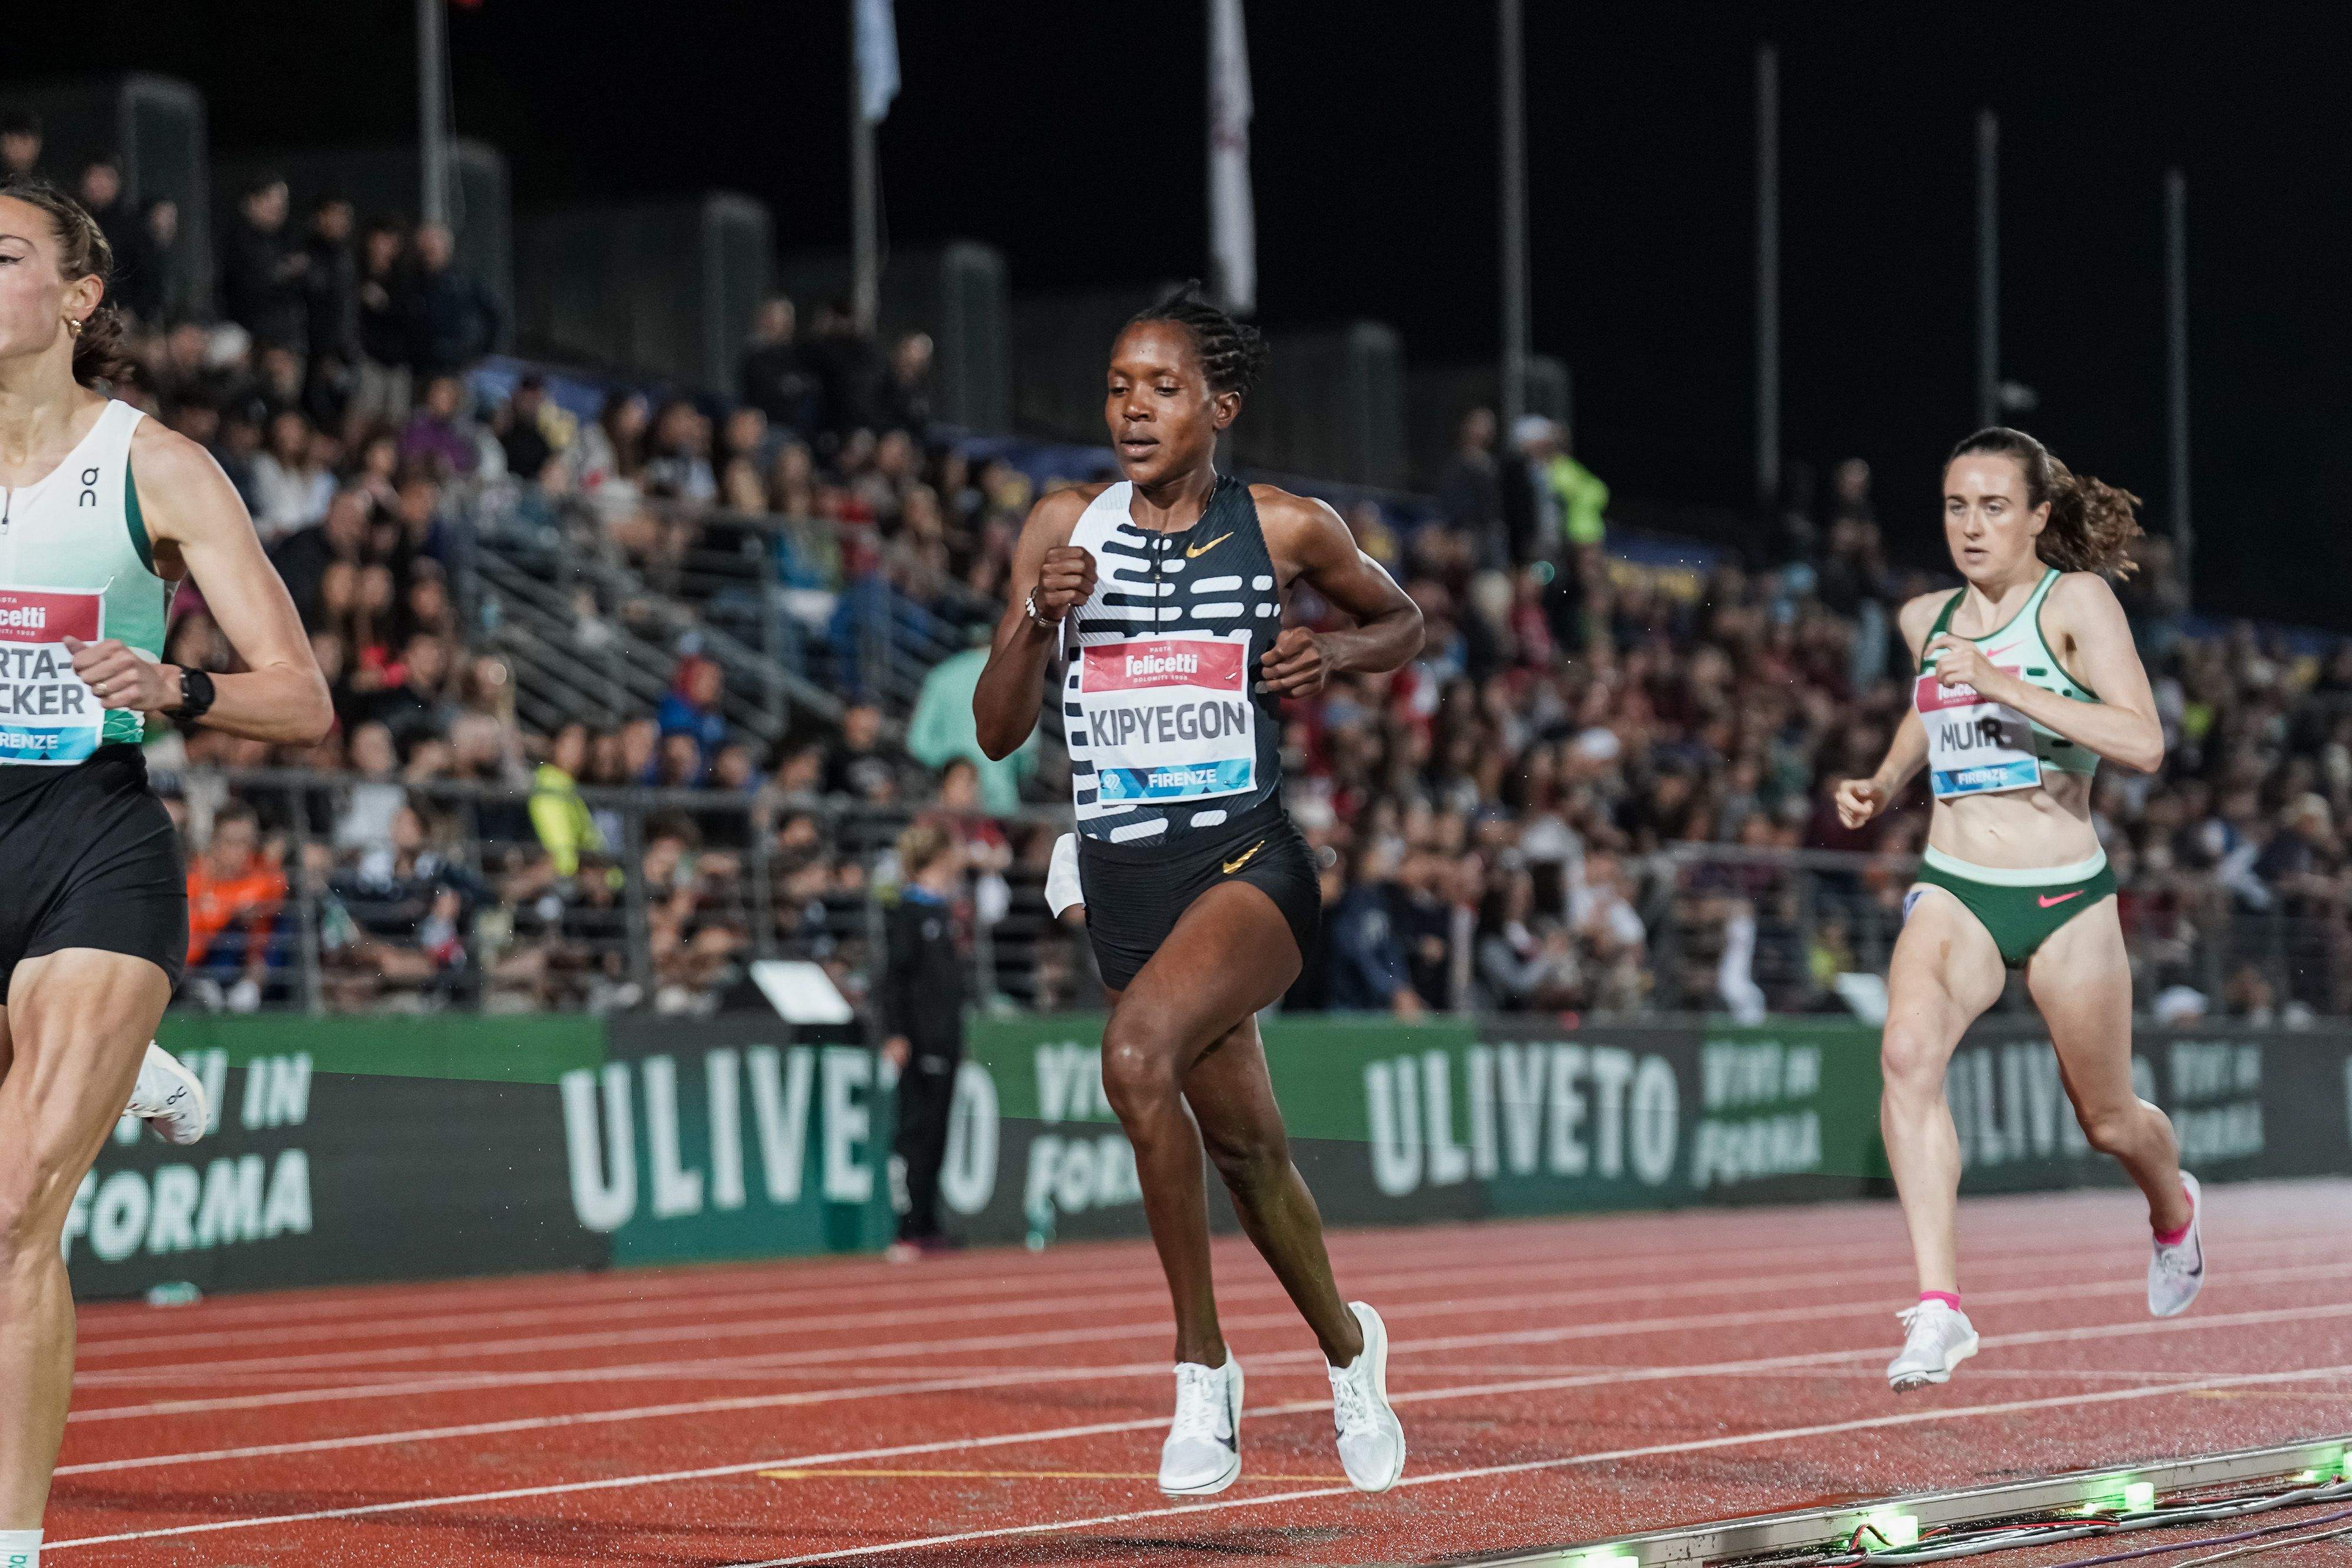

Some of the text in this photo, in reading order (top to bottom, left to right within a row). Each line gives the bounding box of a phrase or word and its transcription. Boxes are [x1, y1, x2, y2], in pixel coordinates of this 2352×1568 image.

[1125, 653, 1198, 678] felicetti
[1089, 700, 1245, 747] KIPYEGON
[1940, 717, 2005, 752] MUIR
[1148, 768, 1217, 788] FIRENZE
[1956, 767, 2009, 785] FIRENZE
[240, 1051, 313, 1130] IN
[559, 1044, 1001, 1233] ULIVEO
[1365, 1041, 1682, 1198] ULIVETO
